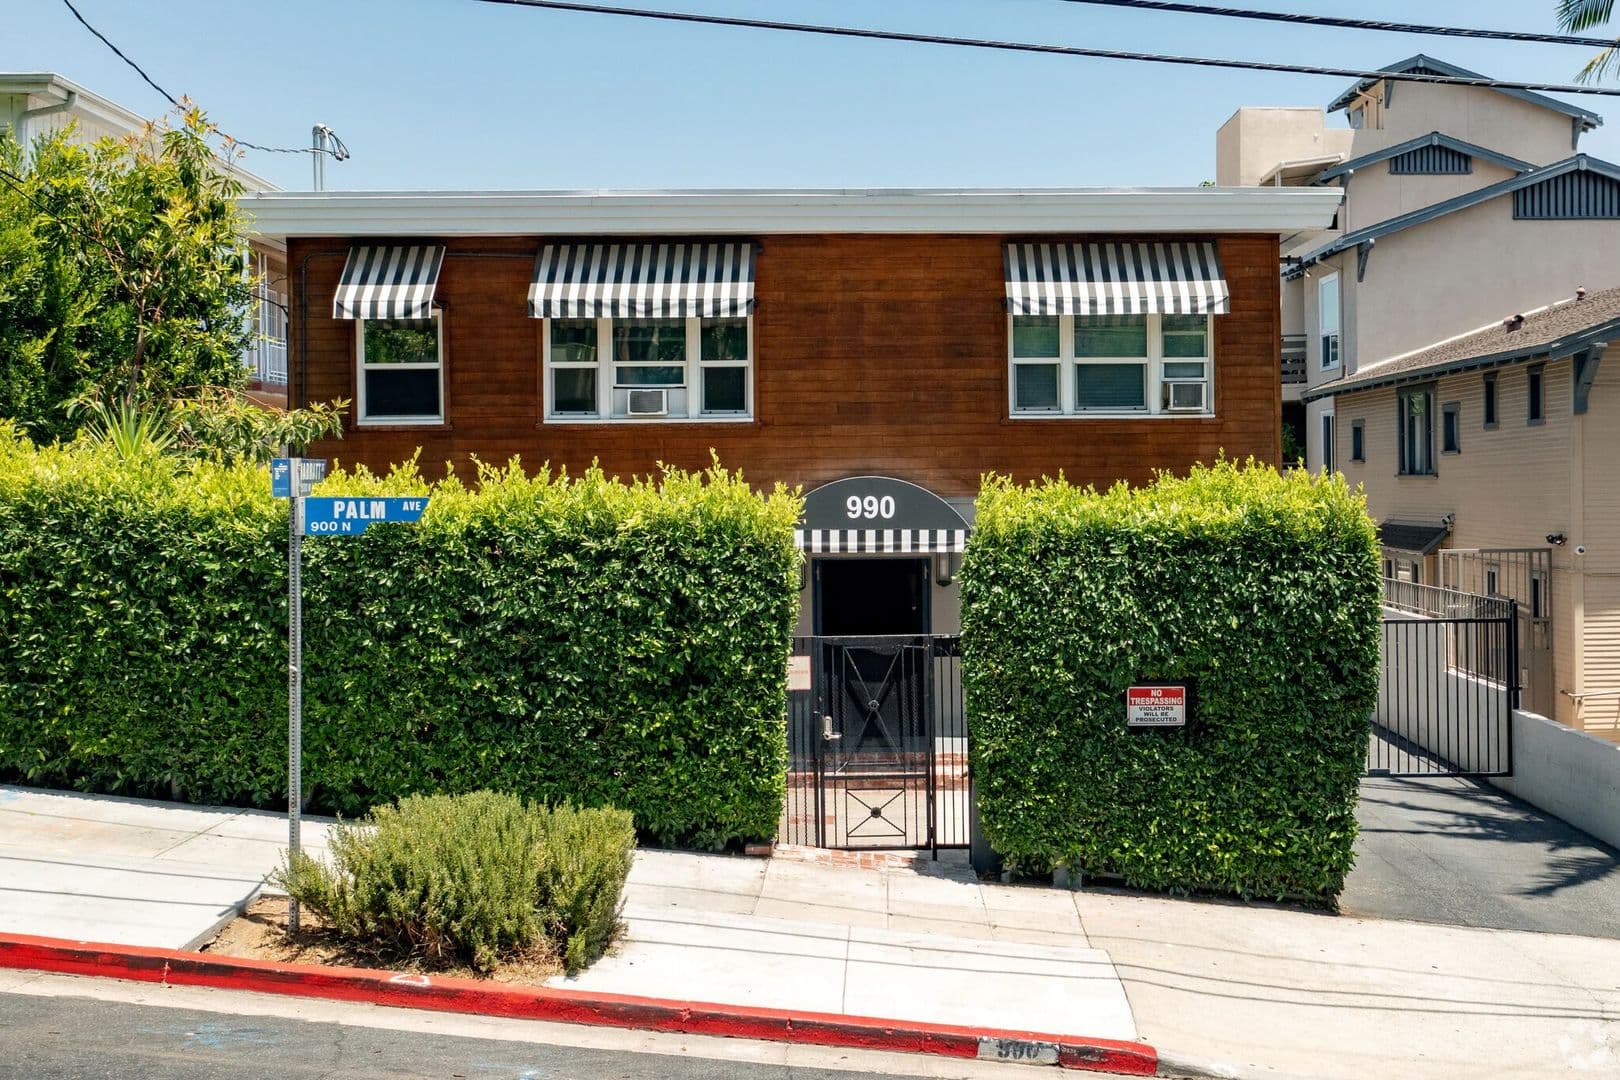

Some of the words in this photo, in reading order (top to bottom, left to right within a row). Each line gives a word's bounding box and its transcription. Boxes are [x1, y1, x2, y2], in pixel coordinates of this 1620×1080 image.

[333, 500, 386, 519] PALM
[402, 501, 421, 511] AVE
[846, 495, 896, 519] 990
[310, 521, 338, 532] 900
[341, 521, 351, 532] N
[1151, 689, 1162, 697] NO
[1130, 697, 1183, 705] TRESPASSING
